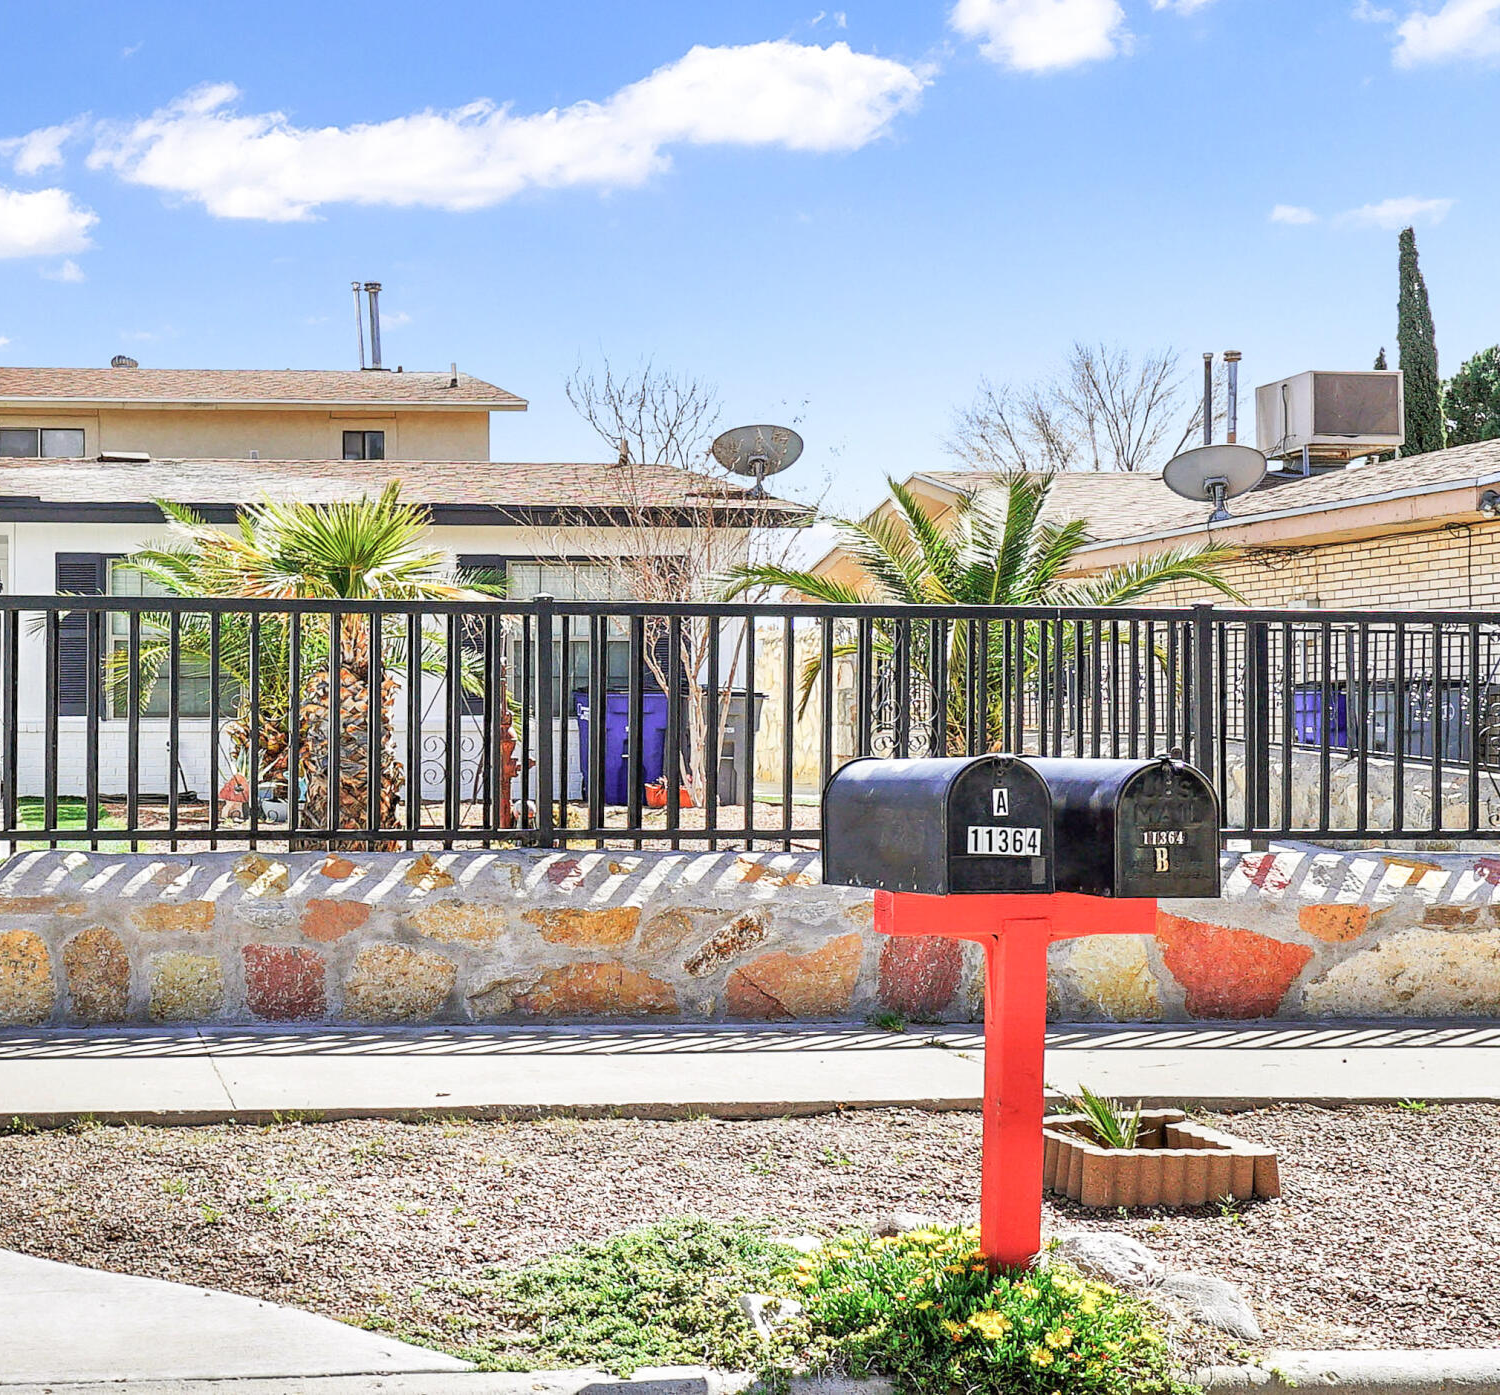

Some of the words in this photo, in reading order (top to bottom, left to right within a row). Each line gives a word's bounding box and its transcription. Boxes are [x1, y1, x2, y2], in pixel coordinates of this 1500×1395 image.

[996, 791, 1007, 813] A
[971, 829, 1037, 853] 11364
[1143, 830, 1185, 846] 11364
[1154, 847, 1170, 873] B
